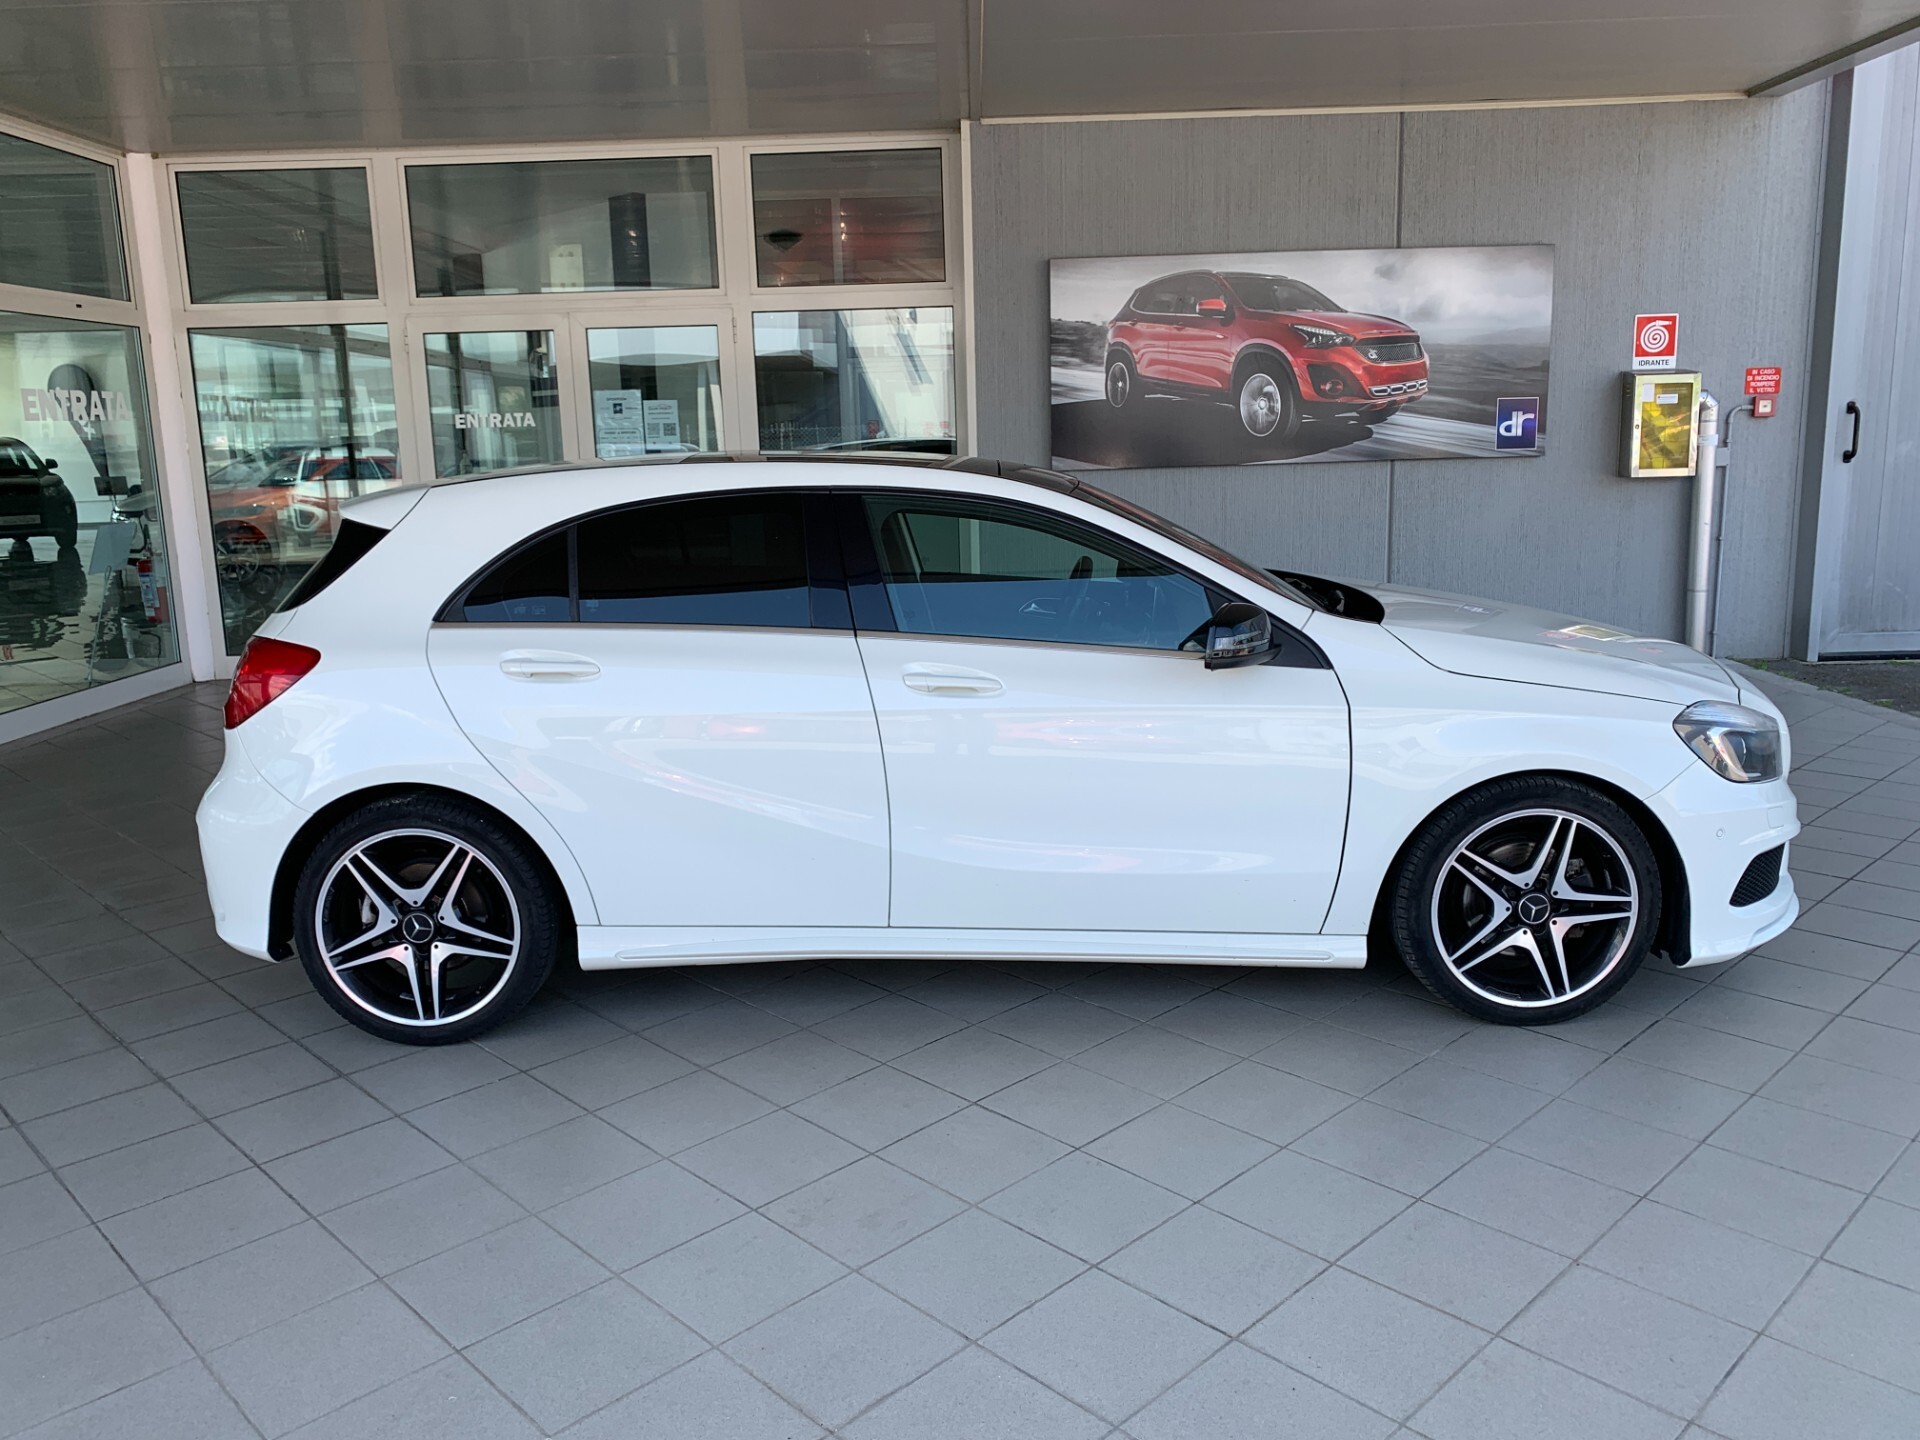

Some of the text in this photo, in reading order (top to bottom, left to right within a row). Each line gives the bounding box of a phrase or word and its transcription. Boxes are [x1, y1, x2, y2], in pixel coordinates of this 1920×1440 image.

[21, 388, 133, 421] ENTRATA
[455, 412, 536, 429] ENTRATA
[1500, 411, 1535, 437] dr
